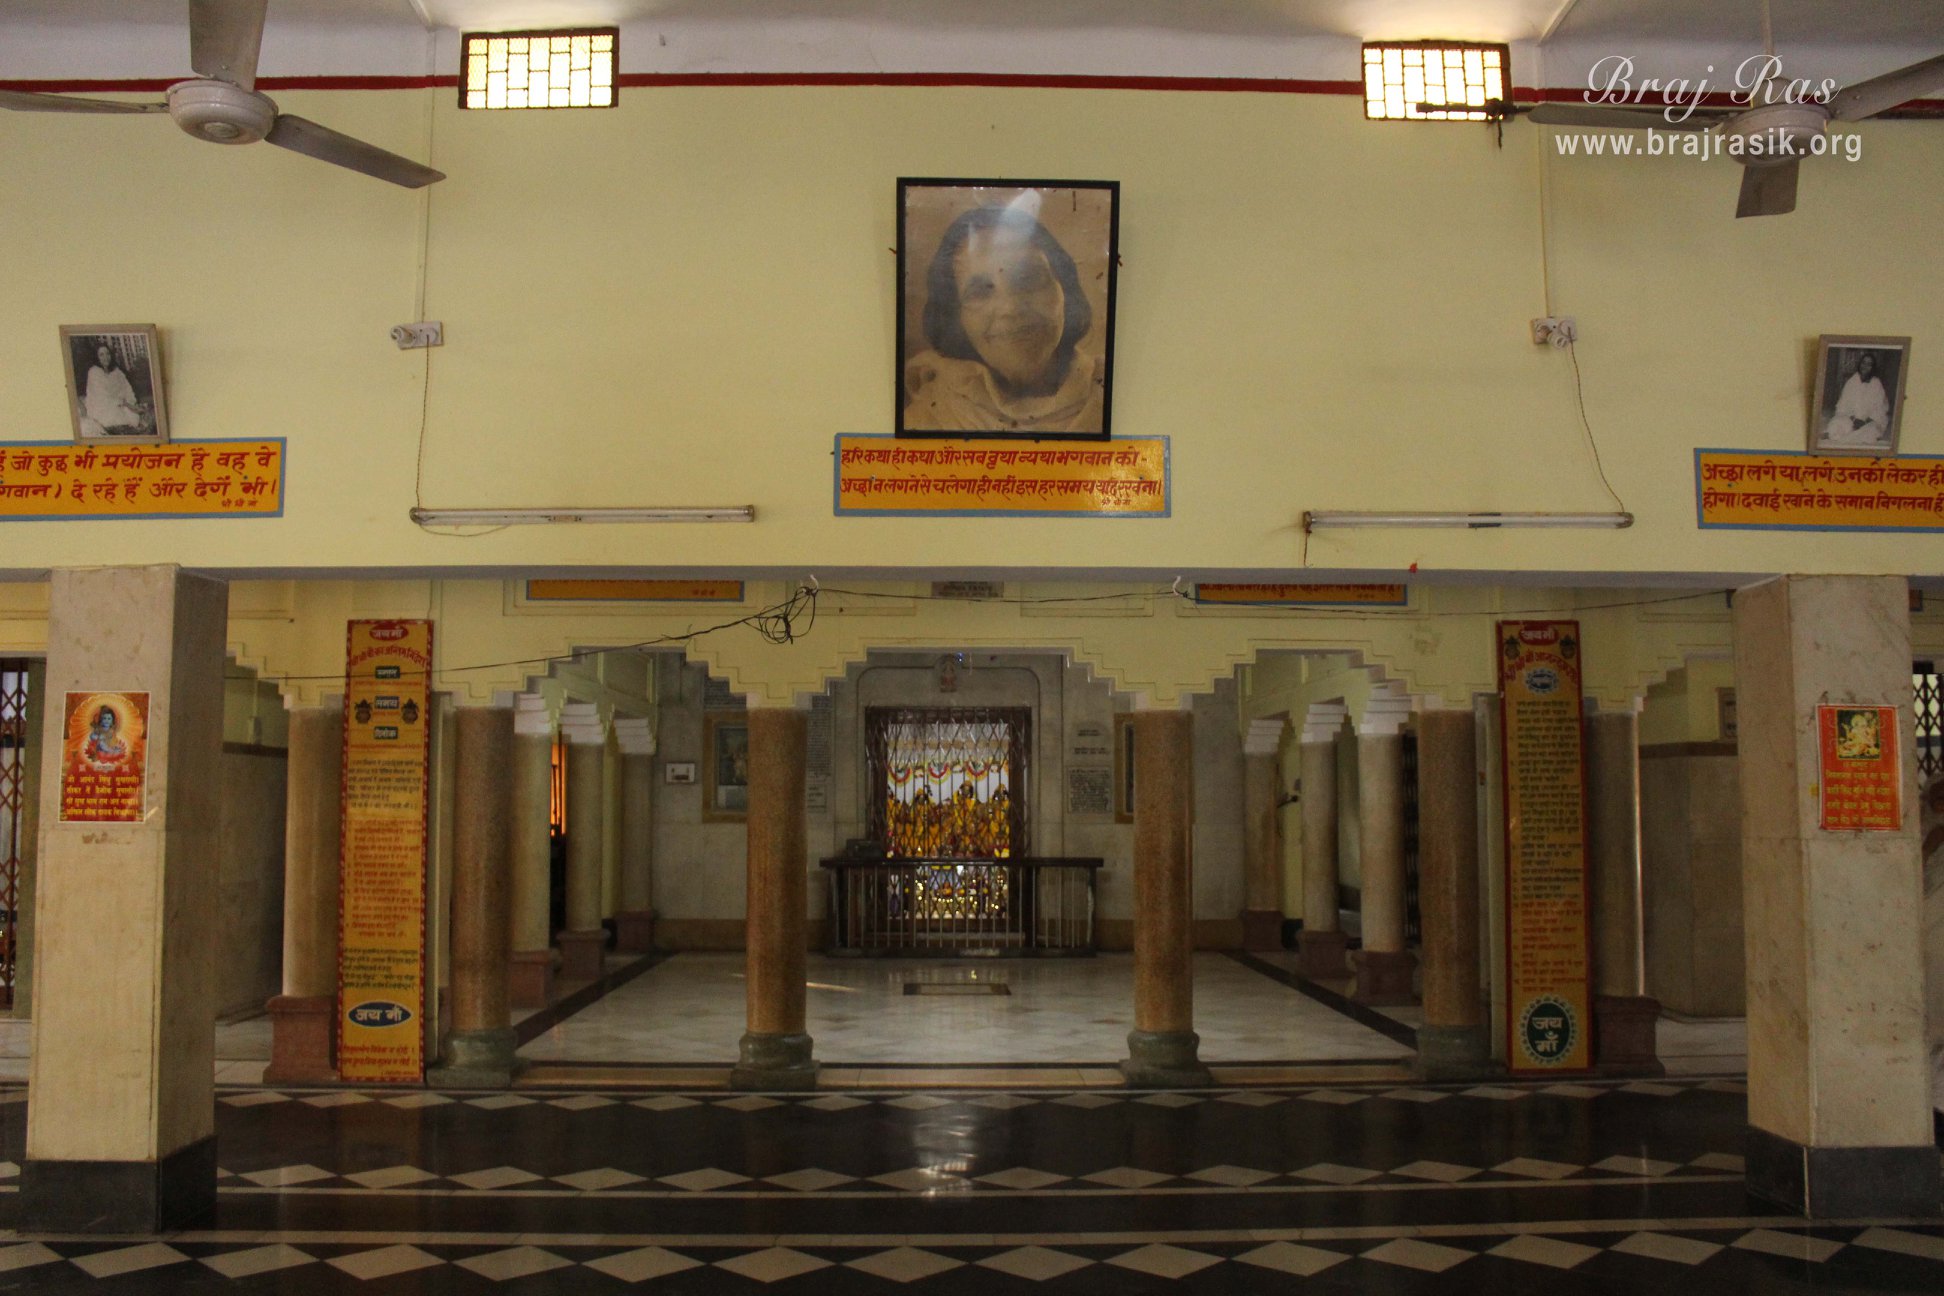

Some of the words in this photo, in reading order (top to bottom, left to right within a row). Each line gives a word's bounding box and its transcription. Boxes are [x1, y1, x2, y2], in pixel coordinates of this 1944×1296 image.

[12, 451, 35, 470] जो
[75, 450, 98, 469] भी
[191, 447, 209, 476] है
[217, 452, 249, 475] वह
[255, 446, 276, 467] वे
[935, 446, 963, 466] और
[963, 450, 987, 467] सब
[1056, 450, 1115, 466] भगवान
[1702, 463, 1745, 484] अच्छा
[1747, 460, 1776, 481] लगे
[1802, 460, 1834, 482] लगे
[1834, 461, 1886, 483] उनको
[1887, 463, 1927, 484] लेकर
[93, 477, 119, 503] रहे
[149, 477, 187, 498] और
[932, 475, 976, 495] चलेगा
[1056, 479, 1096, 496] समय
[1816, 488, 1832, 509] के
[356, 1009, 383, 1021] जय
[1532, 1017, 1563, 1029] जय
